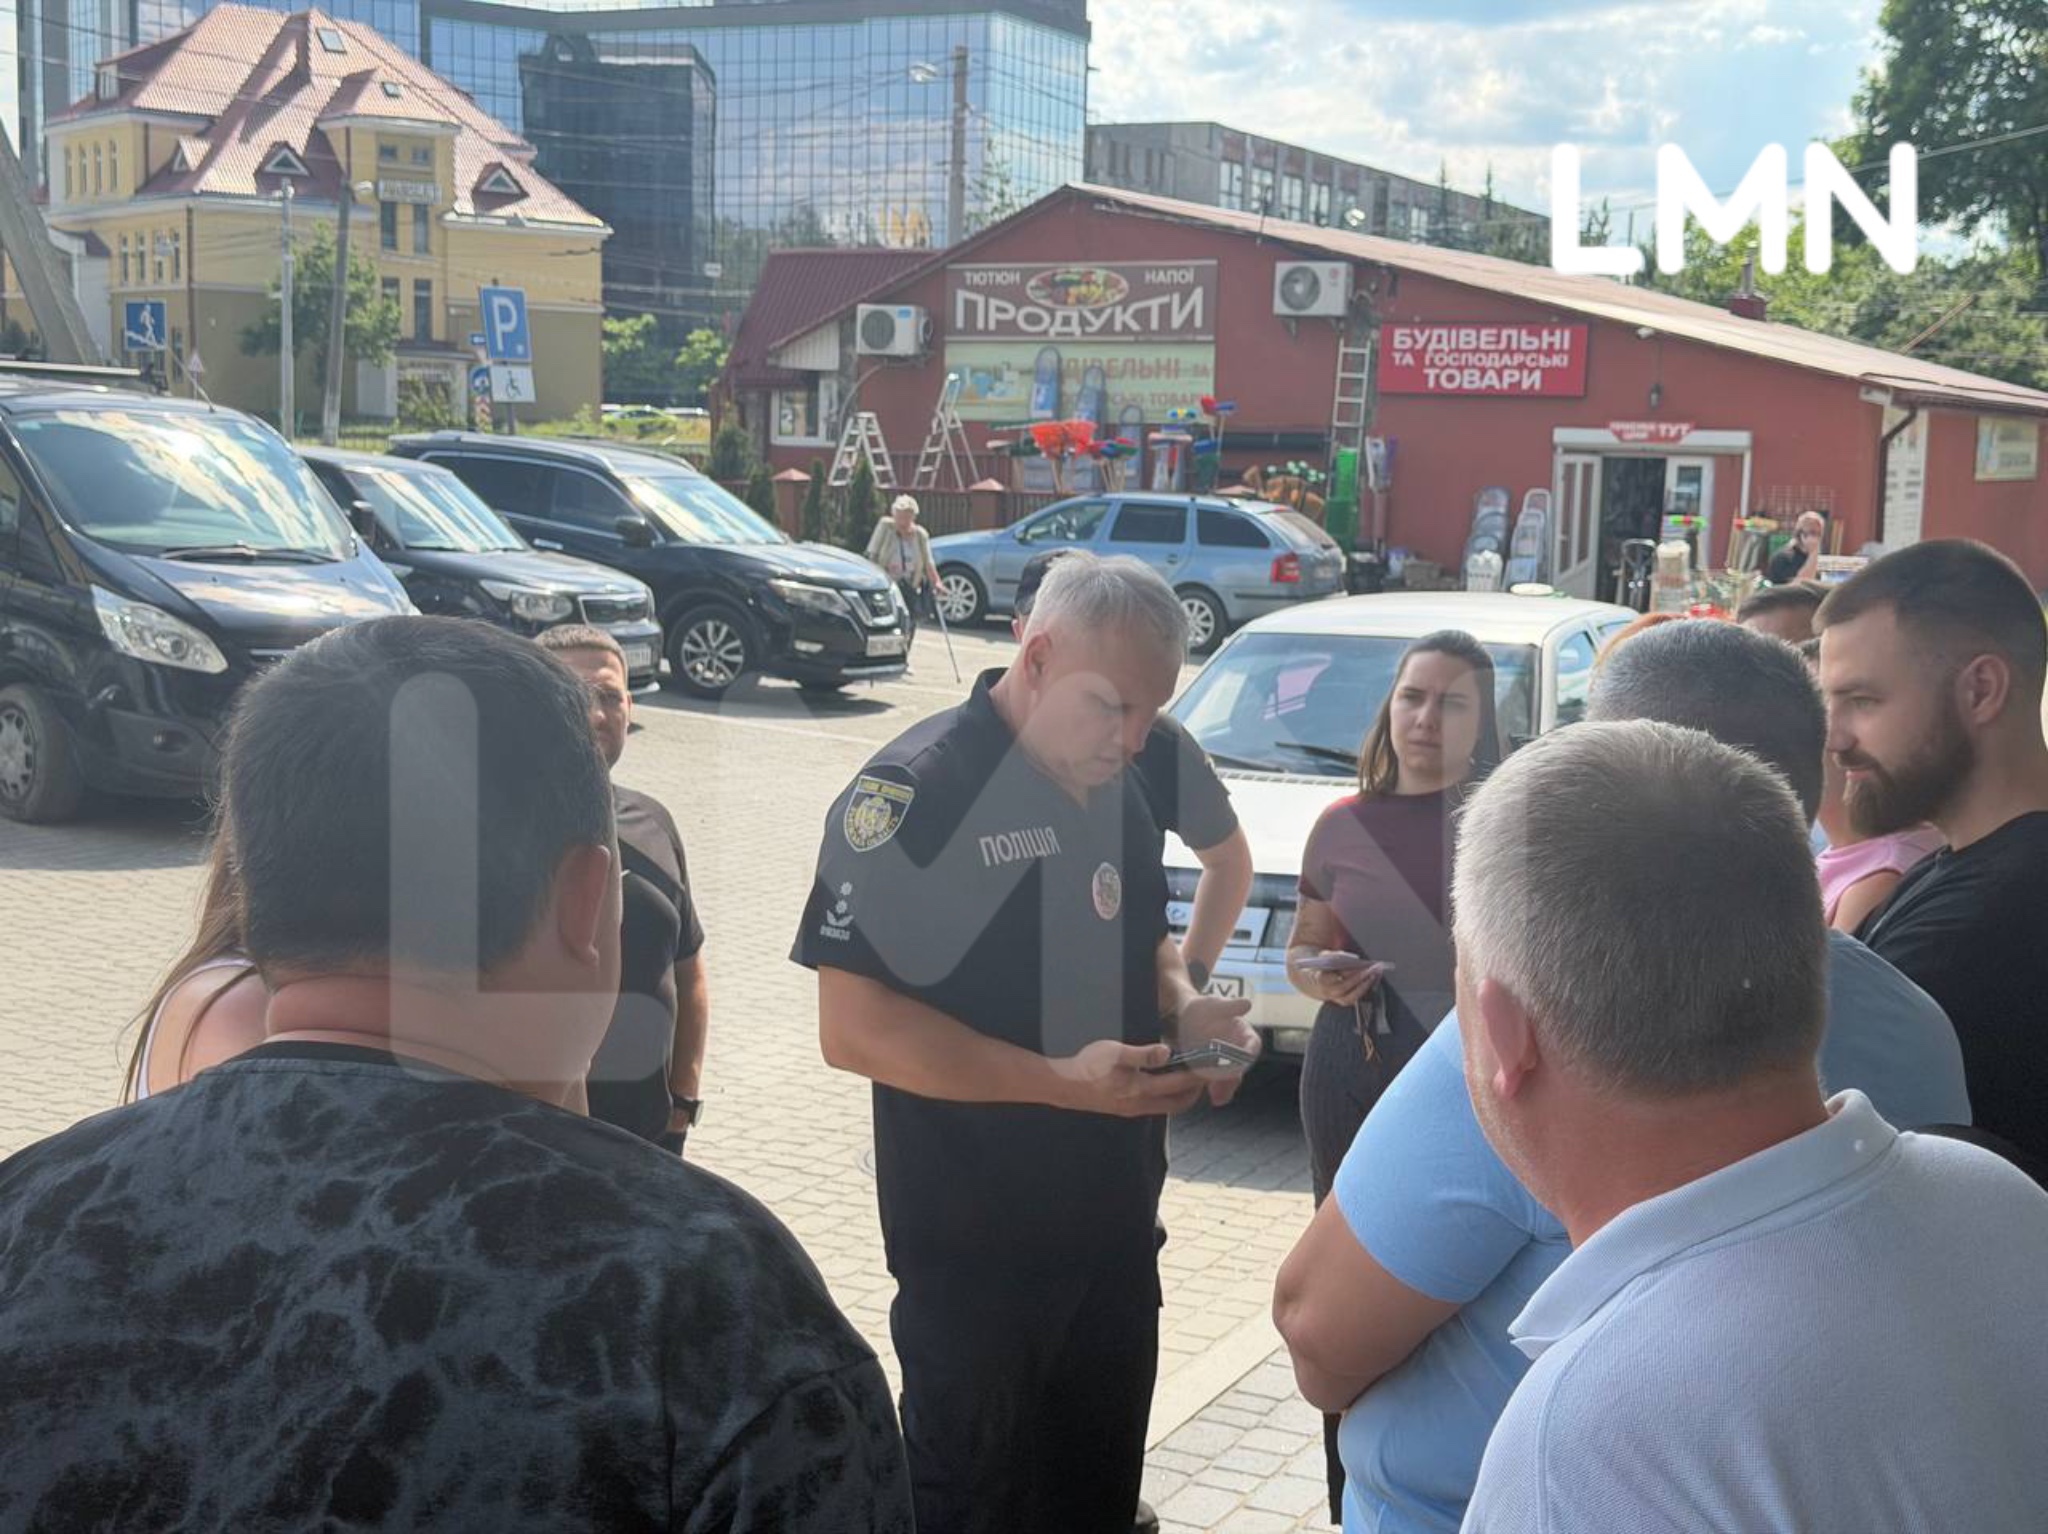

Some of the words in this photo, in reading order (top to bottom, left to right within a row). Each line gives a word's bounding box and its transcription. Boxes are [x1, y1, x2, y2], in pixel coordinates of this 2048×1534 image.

[964, 270, 1021, 286] ТЮТЮН
[1144, 267, 1194, 284] НАПОЇ
[954, 285, 1204, 337] ПРОДУКТИ
[1392, 327, 1571, 352] БУДІВЕЛЬНІ
[1391, 351, 1415, 367] ТА
[1424, 351, 1569, 368] ГОСПОДАРСЬКІ
[1423, 368, 1543, 391] ТОВАРИ
[978, 825, 1062, 868] ПОЛІЦІЯ
